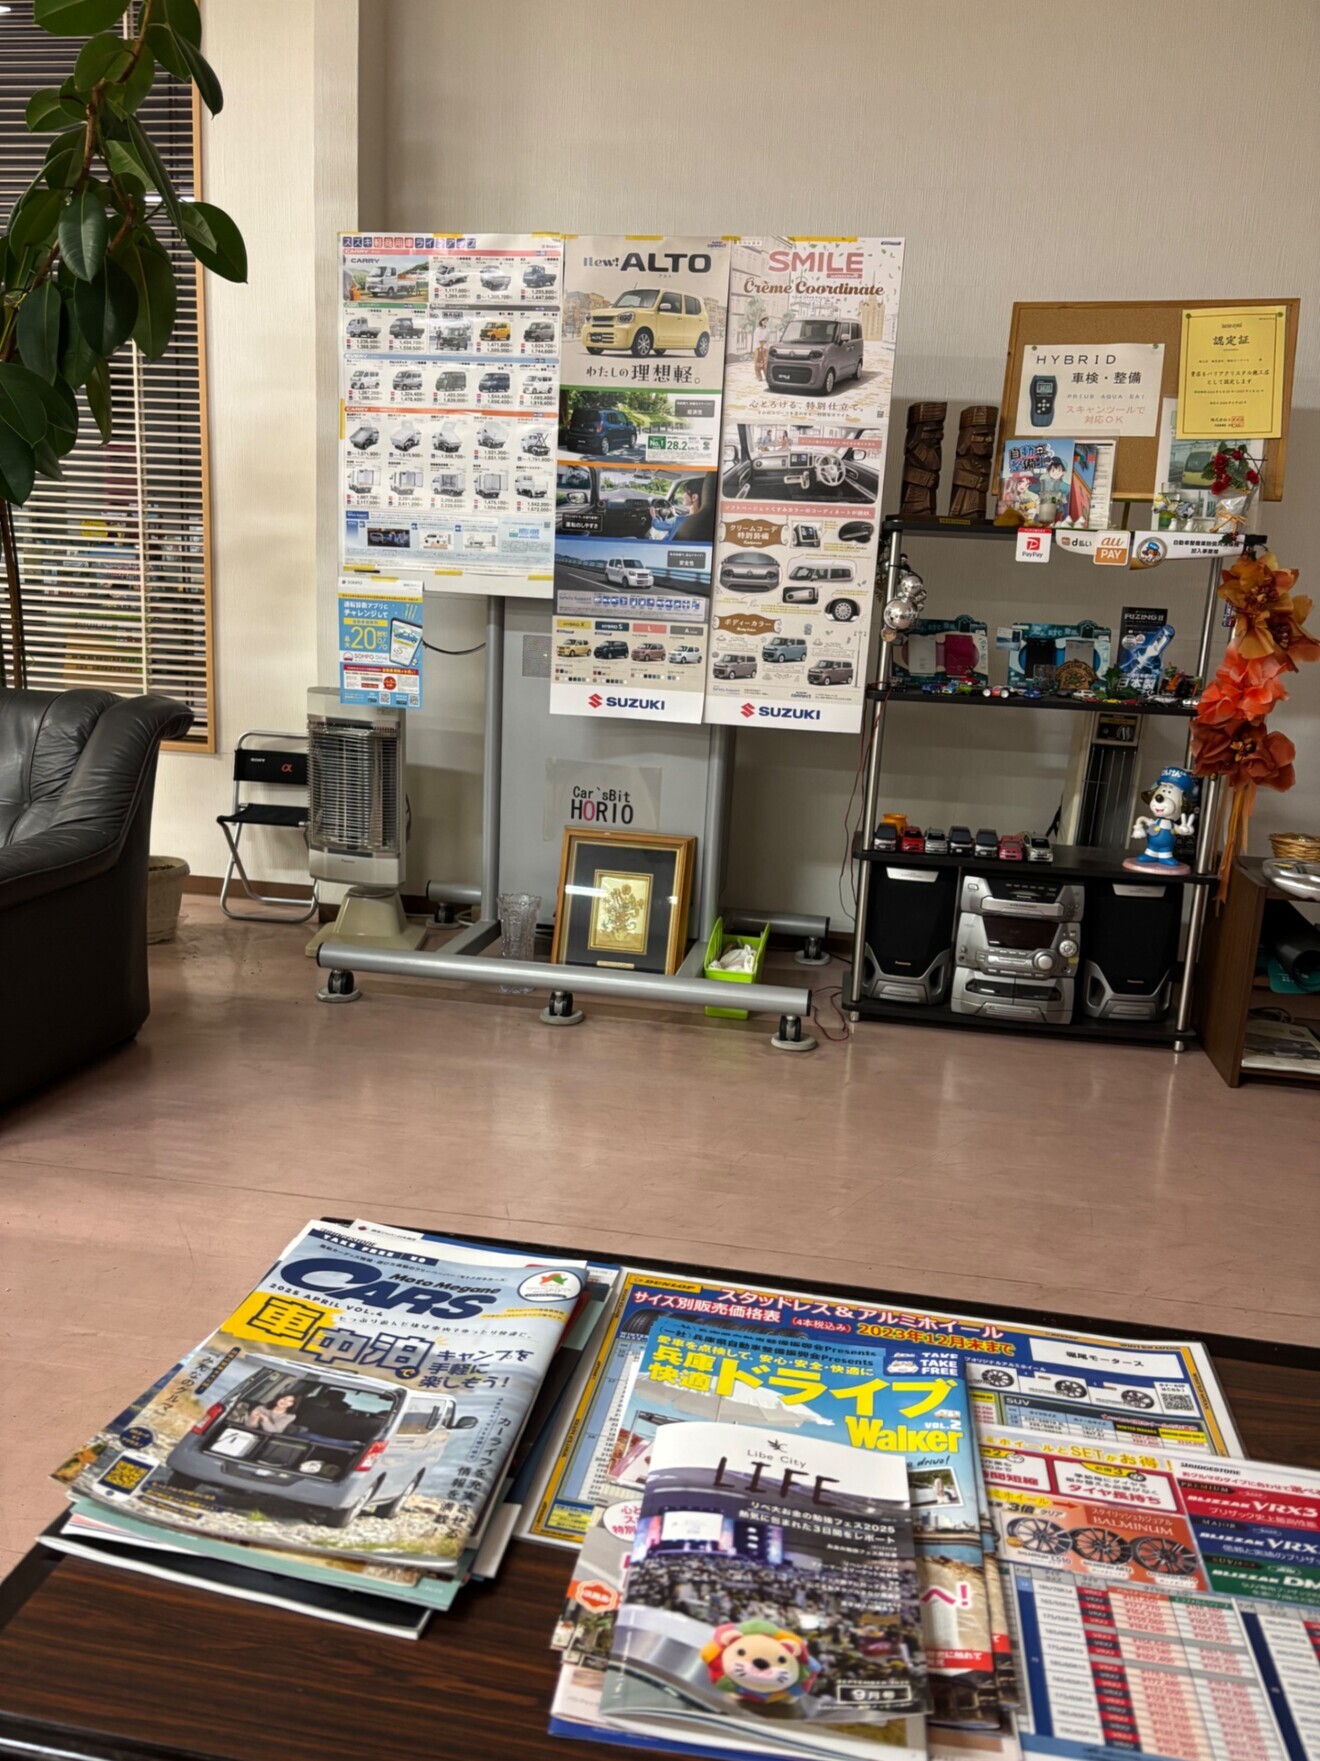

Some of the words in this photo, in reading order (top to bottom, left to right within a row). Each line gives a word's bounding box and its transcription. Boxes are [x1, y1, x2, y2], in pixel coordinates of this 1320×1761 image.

[583, 256, 619, 268] New!
[620, 252, 712, 273] ALTO
[768, 250, 865, 273] SMILE
[794, 279, 885, 296] Coordinate
[1213, 335, 1250, 346] 認定証
[1036, 354, 1117, 365] HYBRID
[586, 364, 701, 384] わたしの理想軽。
[1071, 371, 1142, 384] 車検・整備
[1065, 406, 1146, 414] スキャンツールで
[1084, 415, 1124, 424] 対応OK
[667, 440, 687, 451] 28.2
[730, 524, 779, 533] クリームコーデ
[1101, 537, 1122, 547] au
[1100, 549, 1122, 559] PAY
[724, 618, 772, 627] ボディーカラー
[350, 626, 377, 650] 20
[606, 696, 665, 710] SUZUKI
[758, 706, 821, 720] SUZUKI
[571, 798, 634, 825] HORIO
[323, 1234, 357, 1248] TAKE
[361, 1242, 395, 1258] FREE
[280, 1257, 498, 1320] CARS
[388, 1273, 433, 1286] Moto
[433, 1281, 502, 1295] Megane
[643, 1279, 696, 1290] DUNLOP
[268, 1283, 300, 1296] 2025
[303, 1293, 341, 1309] APRIL
[346, 1305, 384, 1318] VOL.4
[633, 1290, 781, 1323] サイズ別販売価格表
[717, 1287, 1004, 1340] スタッドレス&アルミホイール
[856, 1322, 1016, 1357] 2023年12月末まで
[436, 1349, 535, 1362] キャンプを
[652, 1344, 717, 1372] 兵庫
[920, 1359, 959, 1368] TAKE
[428, 1362, 490, 1375] 手軽に
[921, 1367, 959, 1376] FREE
[648, 1362, 712, 1393] 快適
[715, 1356, 958, 1419] ドライブ
[1006, 1397, 1030, 1406] SUV
[845, 1415, 964, 1453] Walker
[924, 1421, 962, 1431] VOL.2
[747, 1449, 774, 1462] Libe
[780, 1454, 807, 1469] City
[1180, 1462, 1242, 1475] BRIDGESTONE
[713, 1456, 840, 1506] LIFE
[1180, 1481, 1230, 1493] PREMIUM
[1187, 1494, 1250, 1509] BLIZZAK
[1251, 1500, 1318, 1518] VRX3
[751, 1501, 896, 1534] リベ大お金の勉強フェス2025
[738, 1510, 896, 1544] 熱気に包まれた3日間をレポート
[1093, 1517, 1174, 1536] BALMINUM
[1199, 1531, 1265, 1546] BLIZZAK
[1212, 1569, 1280, 1583] BLIZZAK
